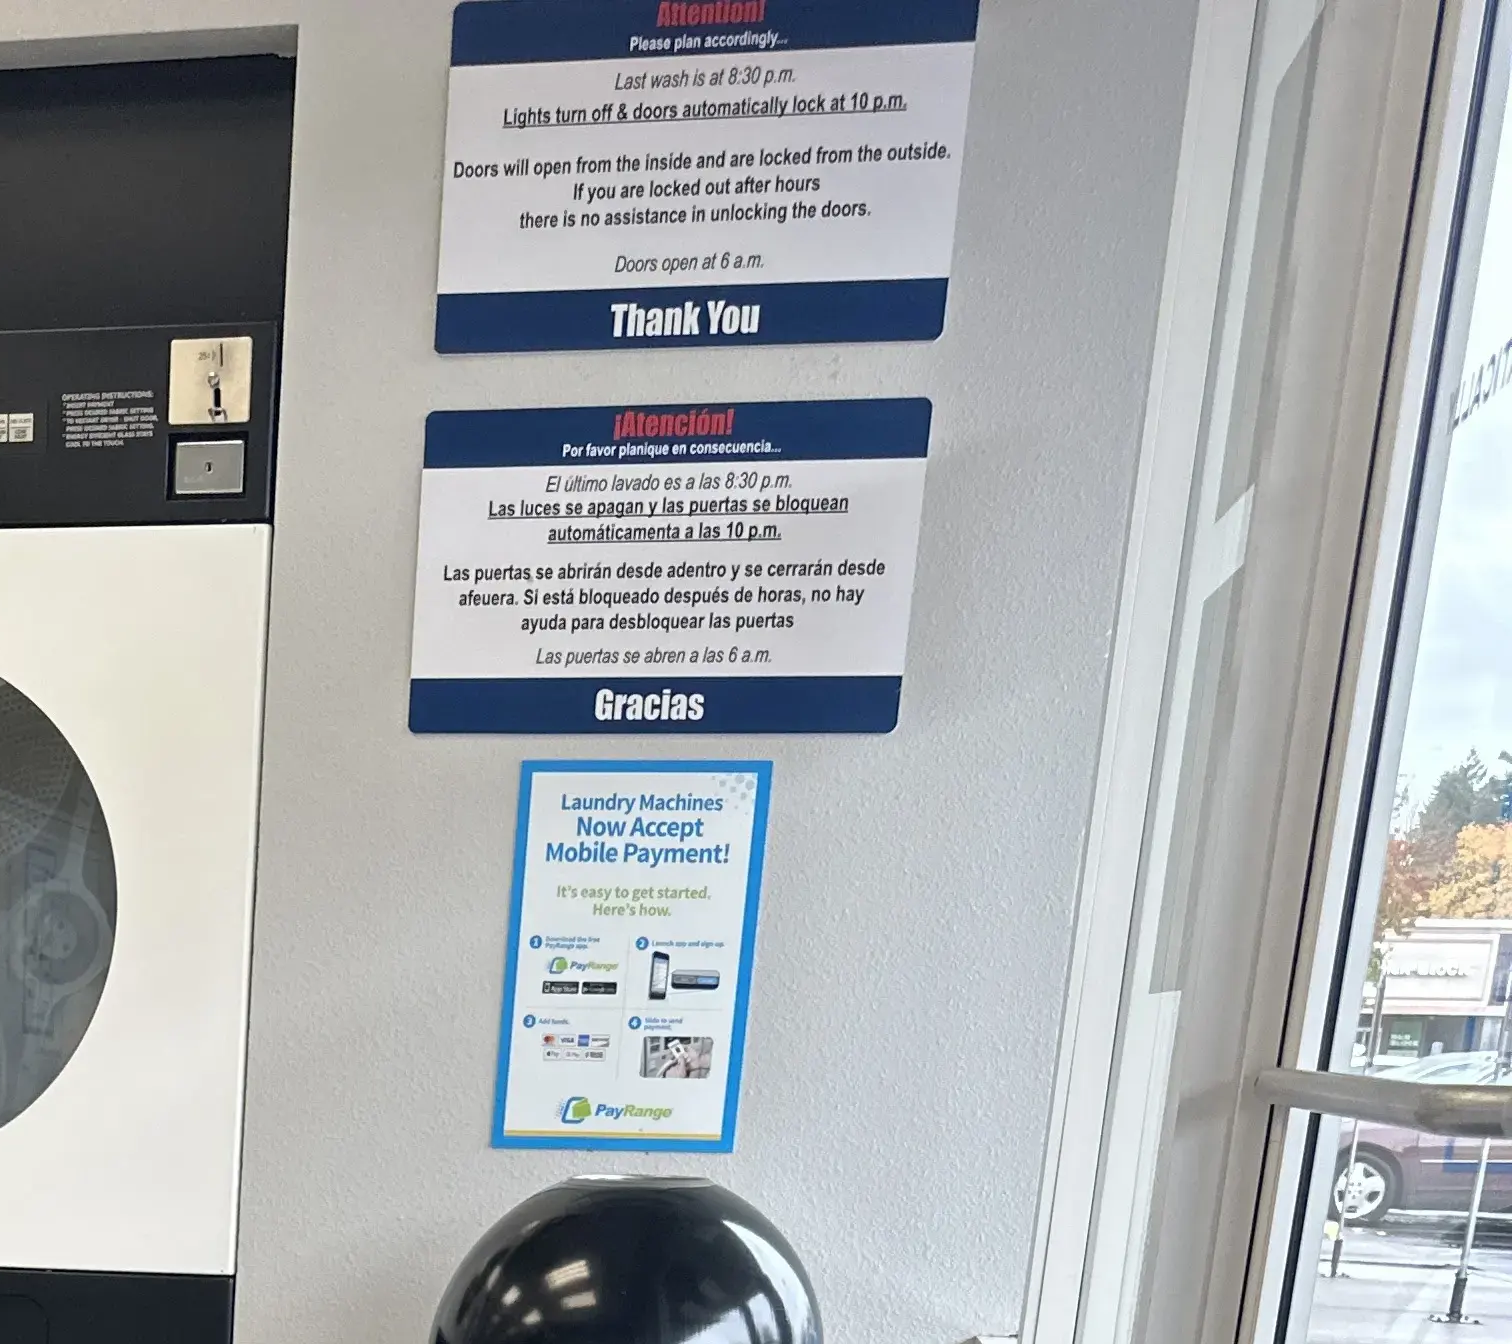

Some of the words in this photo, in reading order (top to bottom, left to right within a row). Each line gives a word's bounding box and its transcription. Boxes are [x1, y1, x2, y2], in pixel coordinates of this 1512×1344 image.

[656, 0, 766, 28] Attention!
[629, 35, 671, 52] Please
[674, 33, 701, 53] plan
[704, 29, 788, 50] accordingly...
[614, 71, 646, 91] Last
[651, 69, 688, 89] wash
[692, 68, 705, 87] is
[709, 69, 724, 86] at
[728, 66, 760, 86] 8:30
[763, 67, 796, 88] p.m.
[503, 107, 550, 129] Lights
[556, 105, 586, 124] turn
[592, 103, 614, 122] off
[617, 104, 628, 120] &
[633, 103, 677, 120] doors
[682, 96, 788, 118] automatically
[792, 94, 825, 113] lock
[830, 94, 845, 111] at
[851, 92, 868, 111] 10
[873, 94, 907, 114] p.m.
[453, 161, 498, 179] Doors
[504, 158, 529, 176] will
[533, 159, 571, 179] open
[576, 156, 611, 174] from
[616, 155, 640, 172] the
[645, 153, 691, 171] inside
[696, 150, 725, 169] and
[730, 153, 754, 168] are
[759, 147, 811, 166] locked
[816, 146, 852, 165] from
[857, 145, 882, 163] the
[887, 142, 951, 161] outside.
[573, 183, 584, 201] If
[587, 185, 615, 204] you
[620, 184, 644, 199] are
[649, 178, 700, 198] locked
[705, 178, 730, 196] out
[735, 175, 771, 194] after
[775, 175, 821, 193] hours
[519, 211, 558, 229] there
[563, 210, 576, 228] is
[580, 212, 600, 227] no
[604, 207, 686, 226] assistance
[691, 204, 705, 223] in
[710, 201, 787, 224] unlocking
[792, 201, 816, 219] the
[821, 200, 872, 218] doors.
[614, 255, 657, 273] Doors
[661, 255, 698, 275] open
[702, 252, 717, 270] at
[720, 251, 730, 269] 6
[733, 253, 764, 269] a.m.
[610, 301, 701, 338] Thank
[707, 300, 761, 335] You
[613, 407, 735, 440] ¡Atención!
[562, 443, 584, 458] Por
[586, 442, 616, 457] favor
[618, 441, 669, 459] planique
[672, 444, 686, 455] en
[689, 439, 781, 455] consecuencia...
[545, 475, 561, 493] El
[564, 474, 608, 492] último
[611, 473, 659, 492] lavado
[664, 476, 681, 491] es
[685, 476, 695, 490] a
[699, 472, 720, 490] las
[724, 471, 758, 490] 8:30
[760, 473, 792, 492] p.m.
[488, 501, 515, 517] Las
[520, 500, 560, 516] luces
[565, 502, 583, 516] se
[588, 500, 644, 518] apagan
[648, 501, 658, 517] y
[662, 496, 684, 514] las
[689, 496, 747, 517] puertas
[752, 499, 770, 512] se
[776, 495, 849, 515] bloquean
[548, 523, 680, 542] automáticamenta
[685, 524, 693, 539] a
[699, 522, 721, 539] las
[726, 521, 744, 539] 10
[748, 522, 782, 541] p.m.
[444, 565, 470, 582] Las
[475, 564, 531, 585] puertas
[535, 566, 553, 580] se
[557, 562, 611, 580] abrirán
[616, 562, 663, 579] desde
[667, 561, 726, 579] adentro
[730, 564, 740, 581] y
[744, 563, 762, 577] se
[767, 558, 833, 577] cerrarán
[838, 558, 885, 576] desde
[458, 589, 519, 606] afeuera.
[523, 588, 538, 605] Si
[542, 588, 575, 605] está
[579, 587, 659, 608] bloqueado
[664, 586, 729, 608] después
[734, 586, 753, 603] de
[757, 586, 806, 605] horas,
[811, 588, 831, 602] no
[835, 585, 865, 605] hay
[521, 614, 567, 634] ayuda
[571, 616, 604, 634] para
[609, 612, 705, 633] desbloquear
[709, 612, 730, 629] las
[735, 612, 794, 633] puertas
[535, 648, 562, 665] Las
[564, 647, 619, 667] puertas
[622, 650, 640, 664] se
[644, 647, 685, 663] abren
[689, 649, 699, 663] a
[702, 646, 724, 663] las
[728, 646, 738, 663] 6
[741, 648, 772, 664] a.m.
[594, 688, 705, 721] Gracias
[561, 792, 636, 815] Laundry
[639, 792, 724, 812] Machines
[577, 816, 626, 837] Now
[629, 816, 704, 842] Accept
[545, 841, 618, 863] Mobile
[623, 842, 730, 868] Payment!
[556, 885, 578, 898] It's
[580, 887, 612, 902] easy
[615, 886, 628, 899] to
[632, 886, 655, 902] get
[657, 885, 711, 900] started.
[593, 903, 636, 916] Here's
[639, 903, 672, 917] how.
[594, 1103, 673, 1120] PayRange
